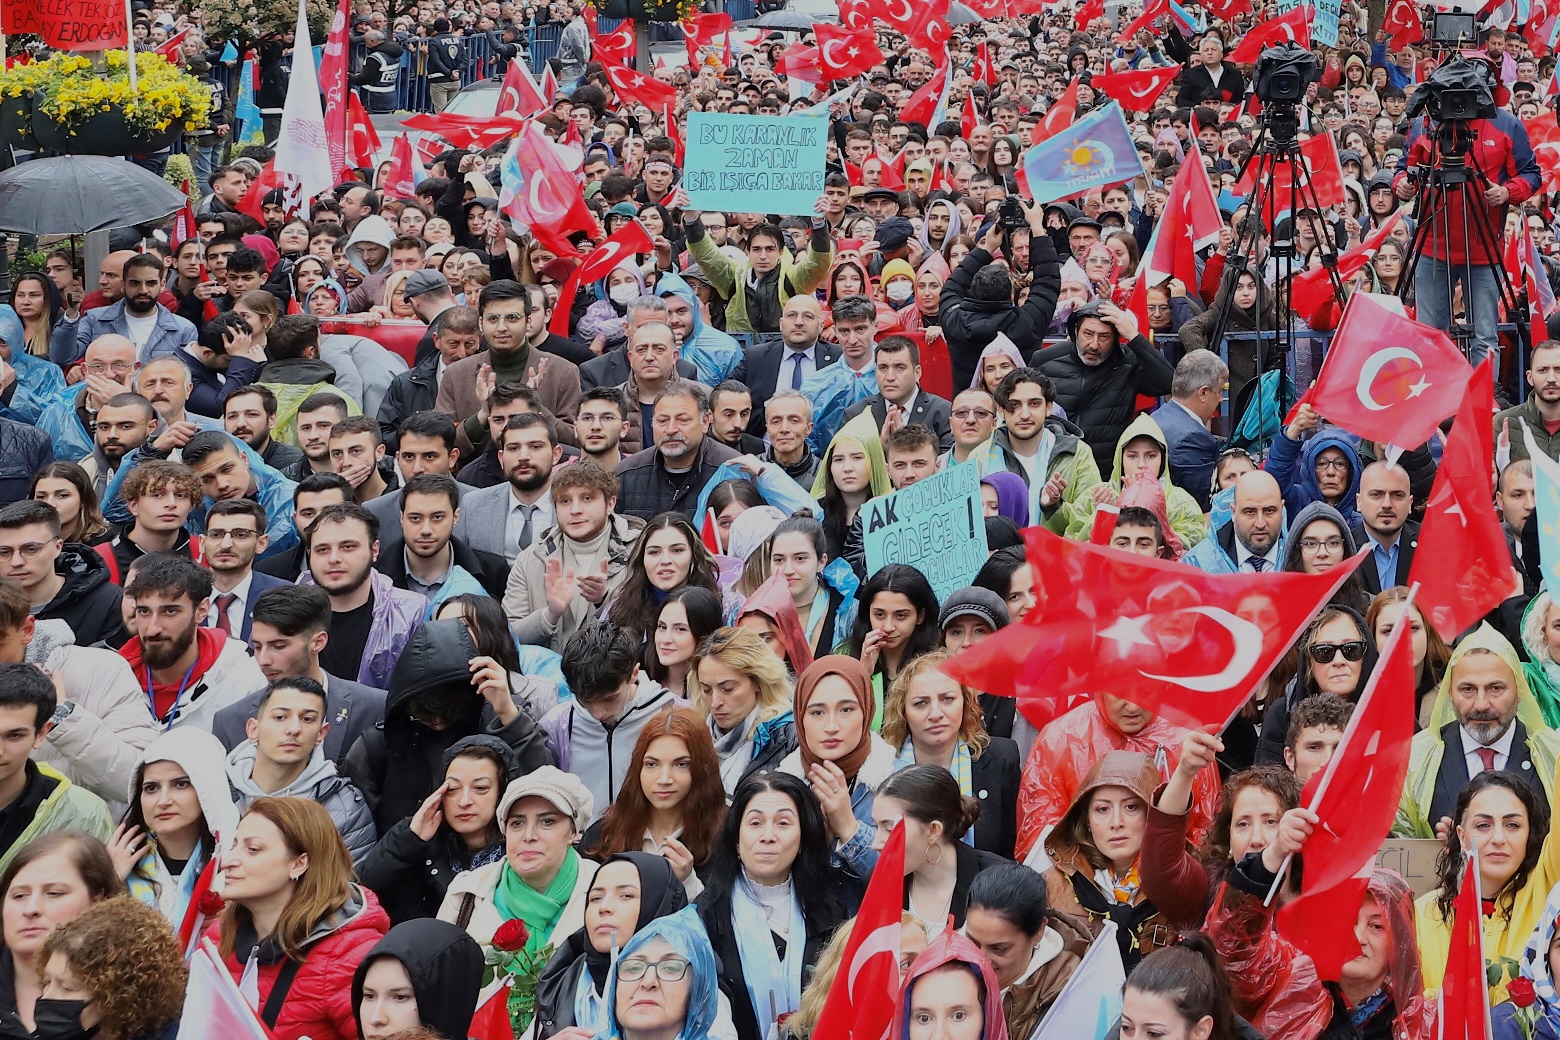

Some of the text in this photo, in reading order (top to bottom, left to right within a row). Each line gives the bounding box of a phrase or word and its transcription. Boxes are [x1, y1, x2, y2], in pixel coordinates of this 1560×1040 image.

[79, 1, 100, 19] TEK
[700, 123, 817, 147] BU KARANLIK
[724, 147, 799, 169] ZAMAN
[687, 169, 716, 192] BİR
[771, 170, 823, 191] BAKAR
[869, 463, 978, 534] AK ÇOCUKLAR
